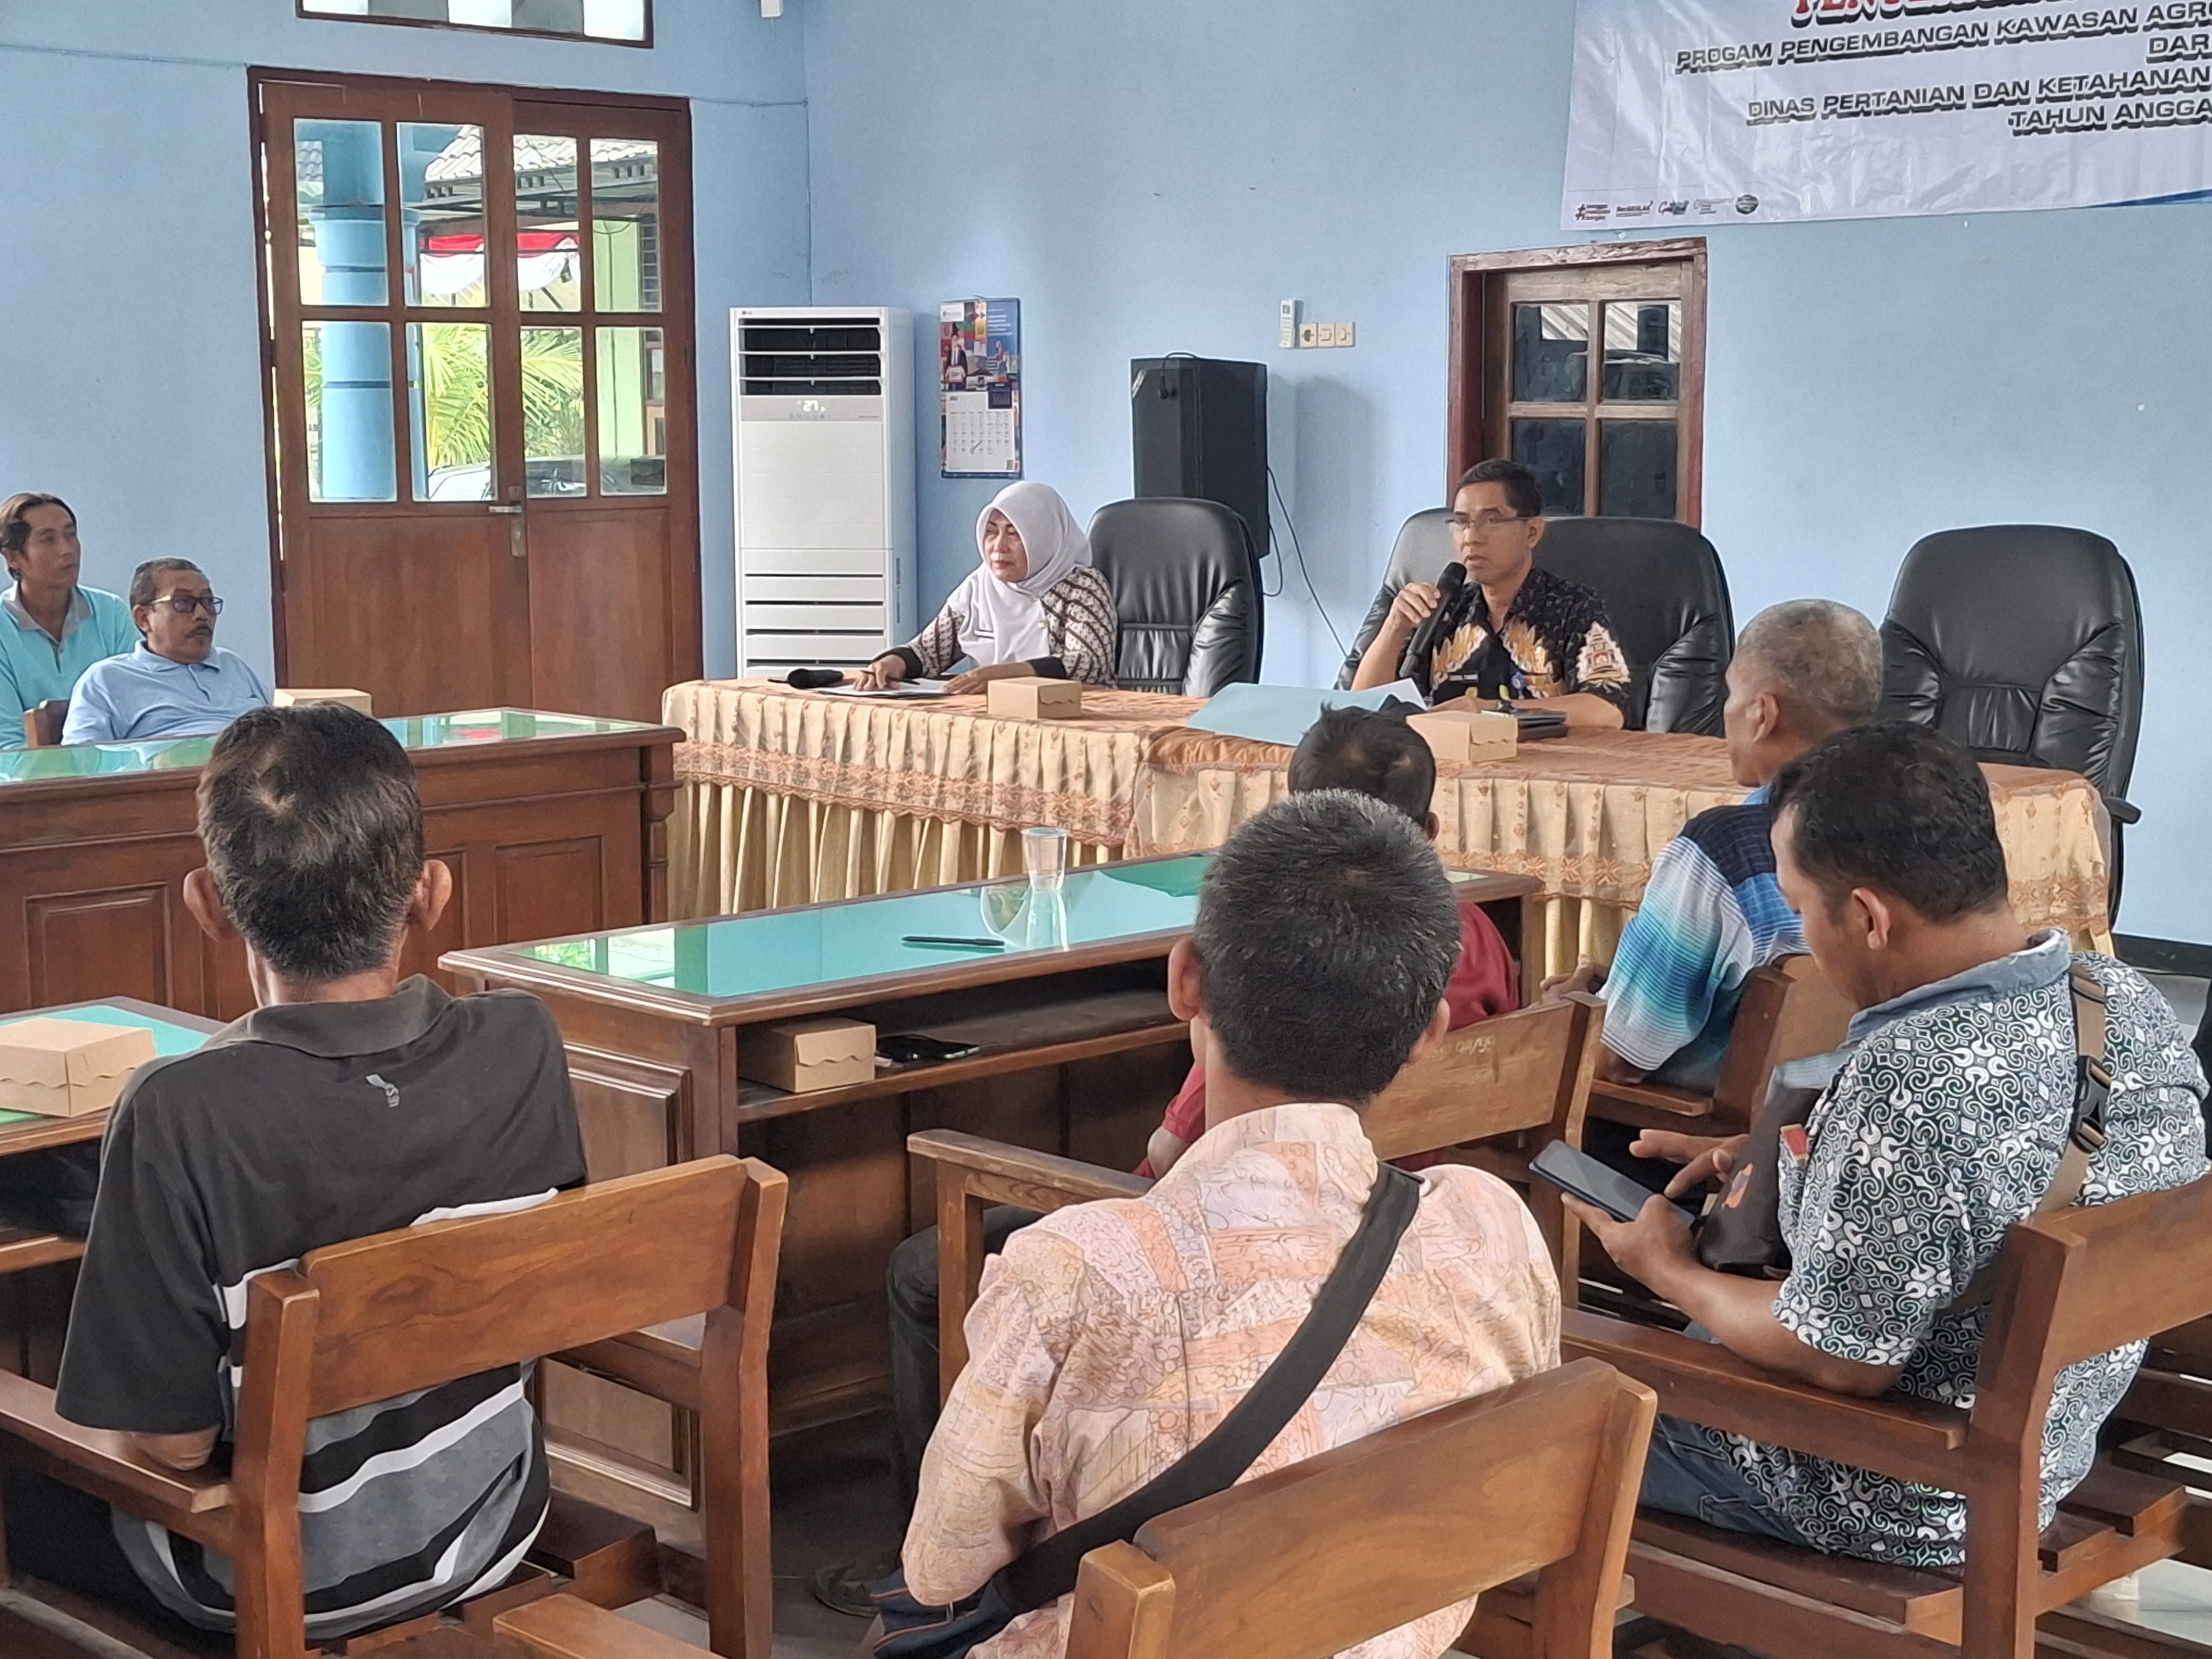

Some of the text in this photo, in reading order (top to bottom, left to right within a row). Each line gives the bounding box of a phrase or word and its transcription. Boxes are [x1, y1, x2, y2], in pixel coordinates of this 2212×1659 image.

[1676, 42, 1772, 67] PROGAM
[1780, 21, 1989, 57] PENGEMBANGAN
[1996, 7, 2138, 36] KAWASAN
[2146, 1, 2212, 23] AGR
[1748, 65, 2211, 118] DINAS PERTANIAN DAN KETAHANAN
[2010, 98, 2212, 128] TAHUN ANGGA
